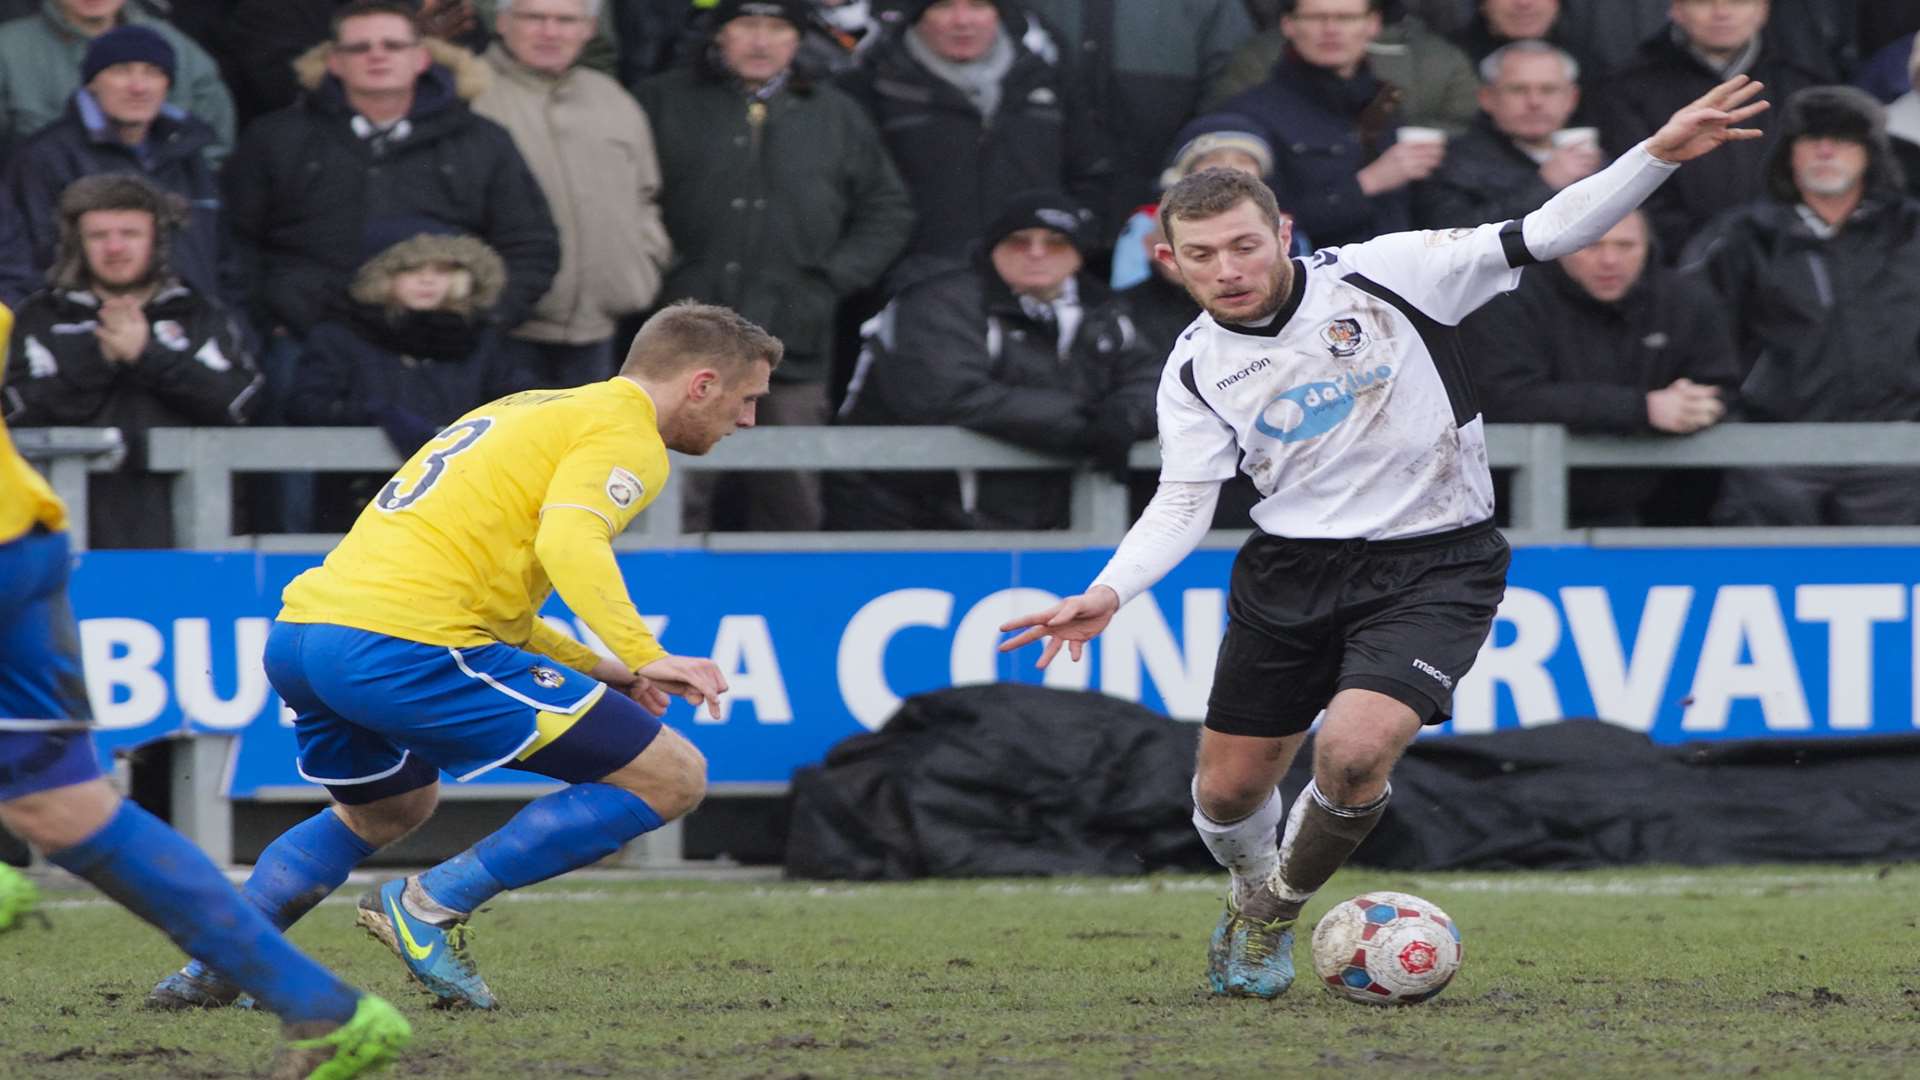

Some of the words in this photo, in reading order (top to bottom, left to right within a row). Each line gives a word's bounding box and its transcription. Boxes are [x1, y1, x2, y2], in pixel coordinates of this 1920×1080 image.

[374, 417, 495, 513] 3
[80, 616, 297, 729] BU
[836, 585, 1920, 735] CONRVAT
